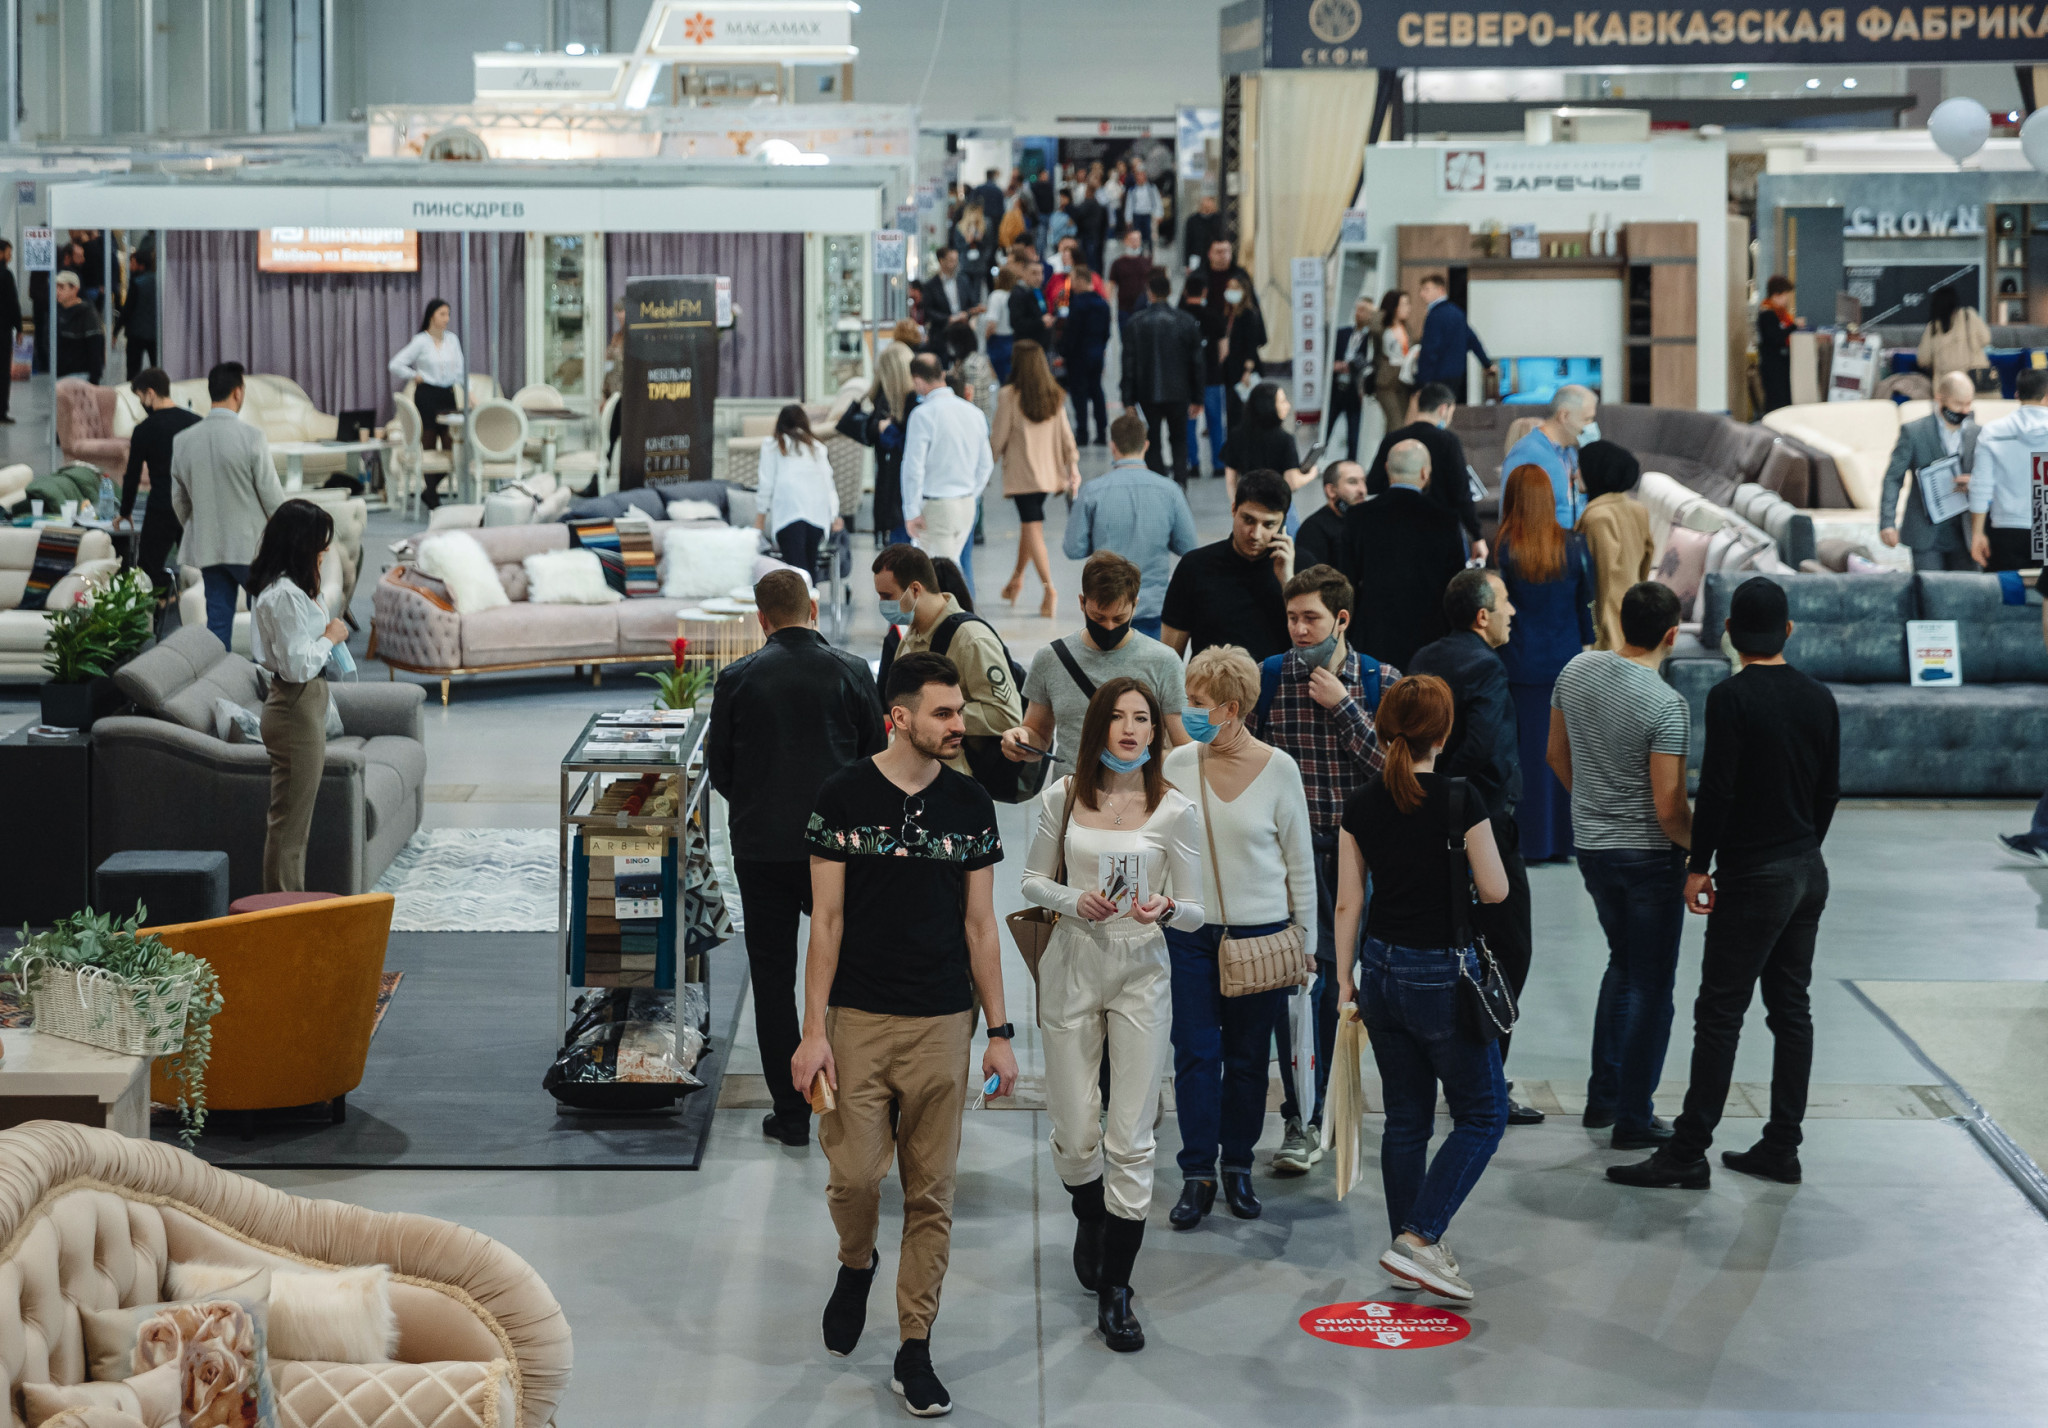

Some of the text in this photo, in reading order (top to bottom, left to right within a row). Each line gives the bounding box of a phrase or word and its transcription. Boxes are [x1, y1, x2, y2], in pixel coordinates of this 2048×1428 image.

[1397, 10, 1845, 47] СЕВЕРО-КАВКАЗСКАЯ
[1495, 174, 1641, 191] ЗАРЕЧЬЕ
[412, 201, 525, 219] ПИНСКДРЕВ
[648, 382, 691, 401] ТУРЦИИ
[644, 455, 690, 471] СТИЛЬ
[592, 840, 656, 851] ARBEN
[625, 857, 650, 865] BINGO
